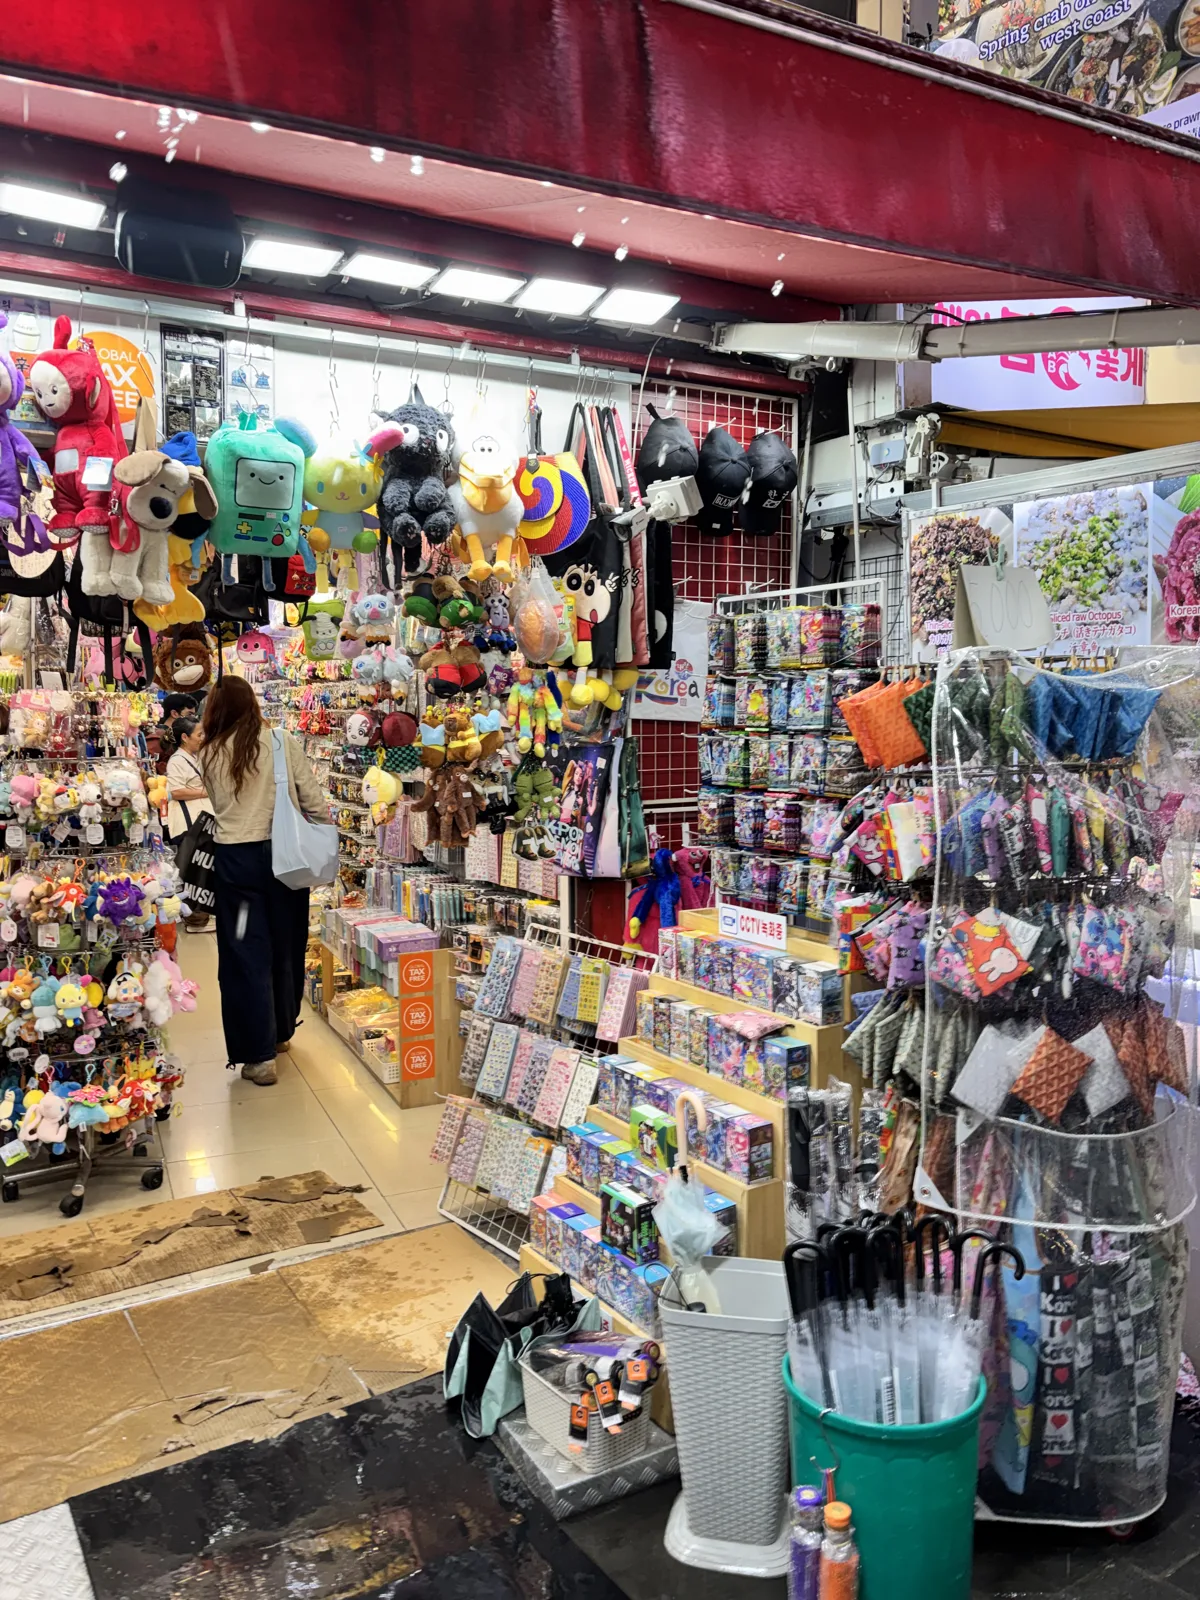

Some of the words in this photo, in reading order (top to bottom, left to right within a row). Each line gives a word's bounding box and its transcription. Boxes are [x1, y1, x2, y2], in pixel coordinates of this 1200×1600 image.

[979, 24, 1030, 60] Spring
[1033, 2, 1071, 32] crab
[1040, 20, 1079, 50] west
[1083, 1, 1131, 30] coast
[99, 348, 138, 363] OBAL
[101, 362, 138, 389] AX
[112, 389, 137, 409] EE
[1072, 611, 1087, 621] raw
[1088, 610, 1121, 622] Octopus
[634, 671, 700, 706] Korea
[408, 968, 425, 976] TAX
[409, 1012, 426, 1020] TAX
[410, 1055, 427, 1063] TAX
